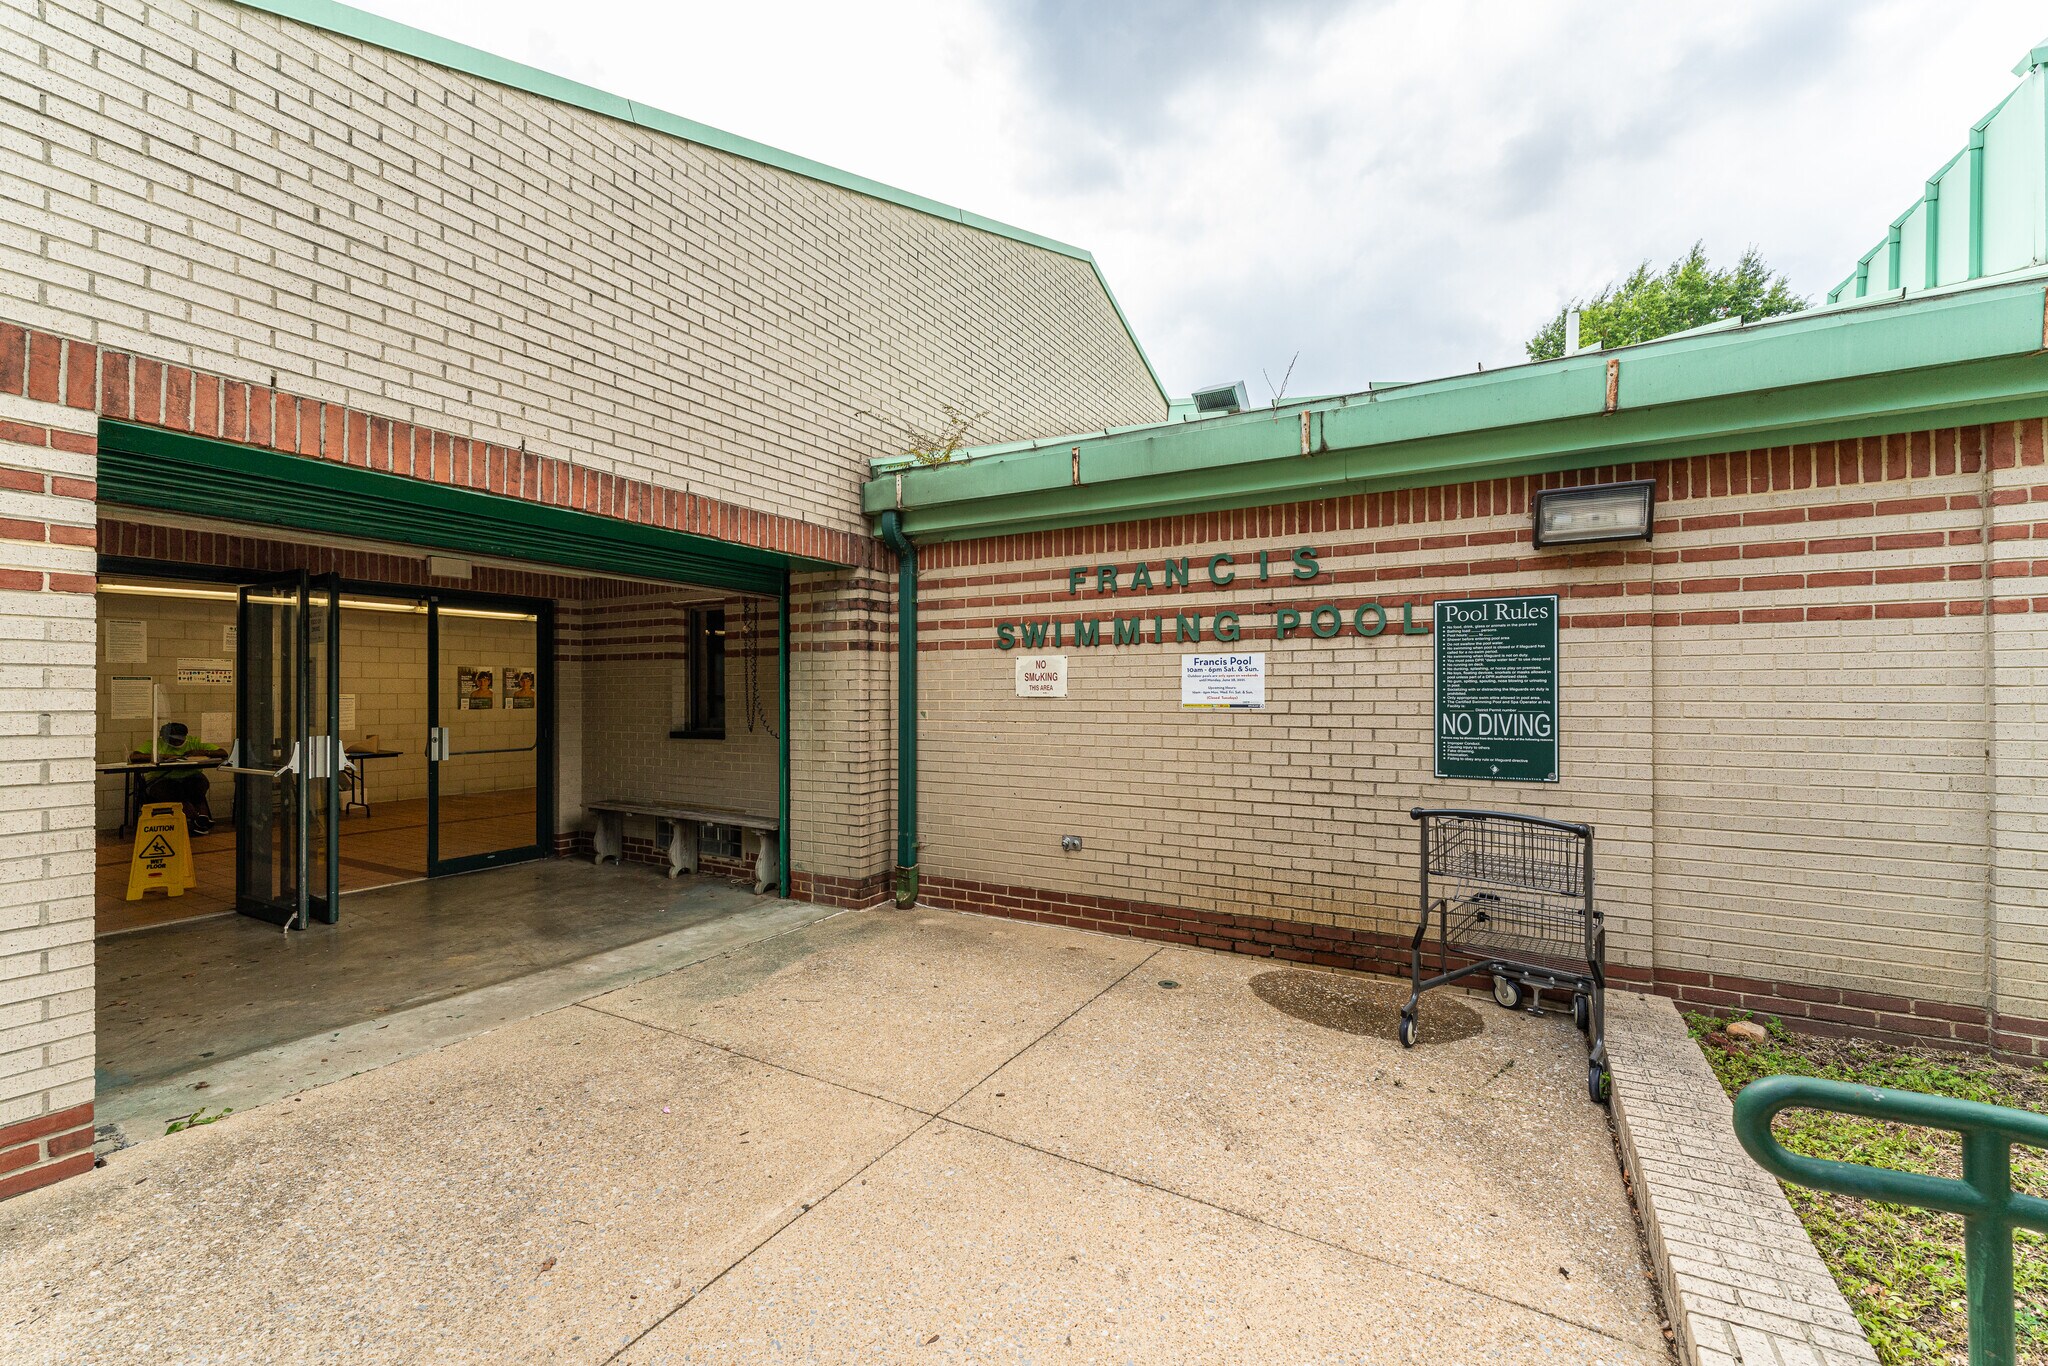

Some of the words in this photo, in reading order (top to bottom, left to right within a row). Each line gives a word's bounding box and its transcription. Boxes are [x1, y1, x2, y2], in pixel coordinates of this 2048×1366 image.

[1070, 547, 1319, 594] FRANCIS
[1445, 604, 1488, 622] Pool
[1494, 602, 1548, 620] Rules
[996, 611, 1240, 650] SWIMMING
[1276, 602, 1428, 640] POOL
[1036, 660, 1046, 669] NO
[1194, 658, 1227, 666] Francis
[1230, 656, 1251, 665] Pool
[1024, 672, 1058, 681] SMOKING
[1443, 713, 1472, 735] NO
[1479, 714, 1551, 737] DIVING
